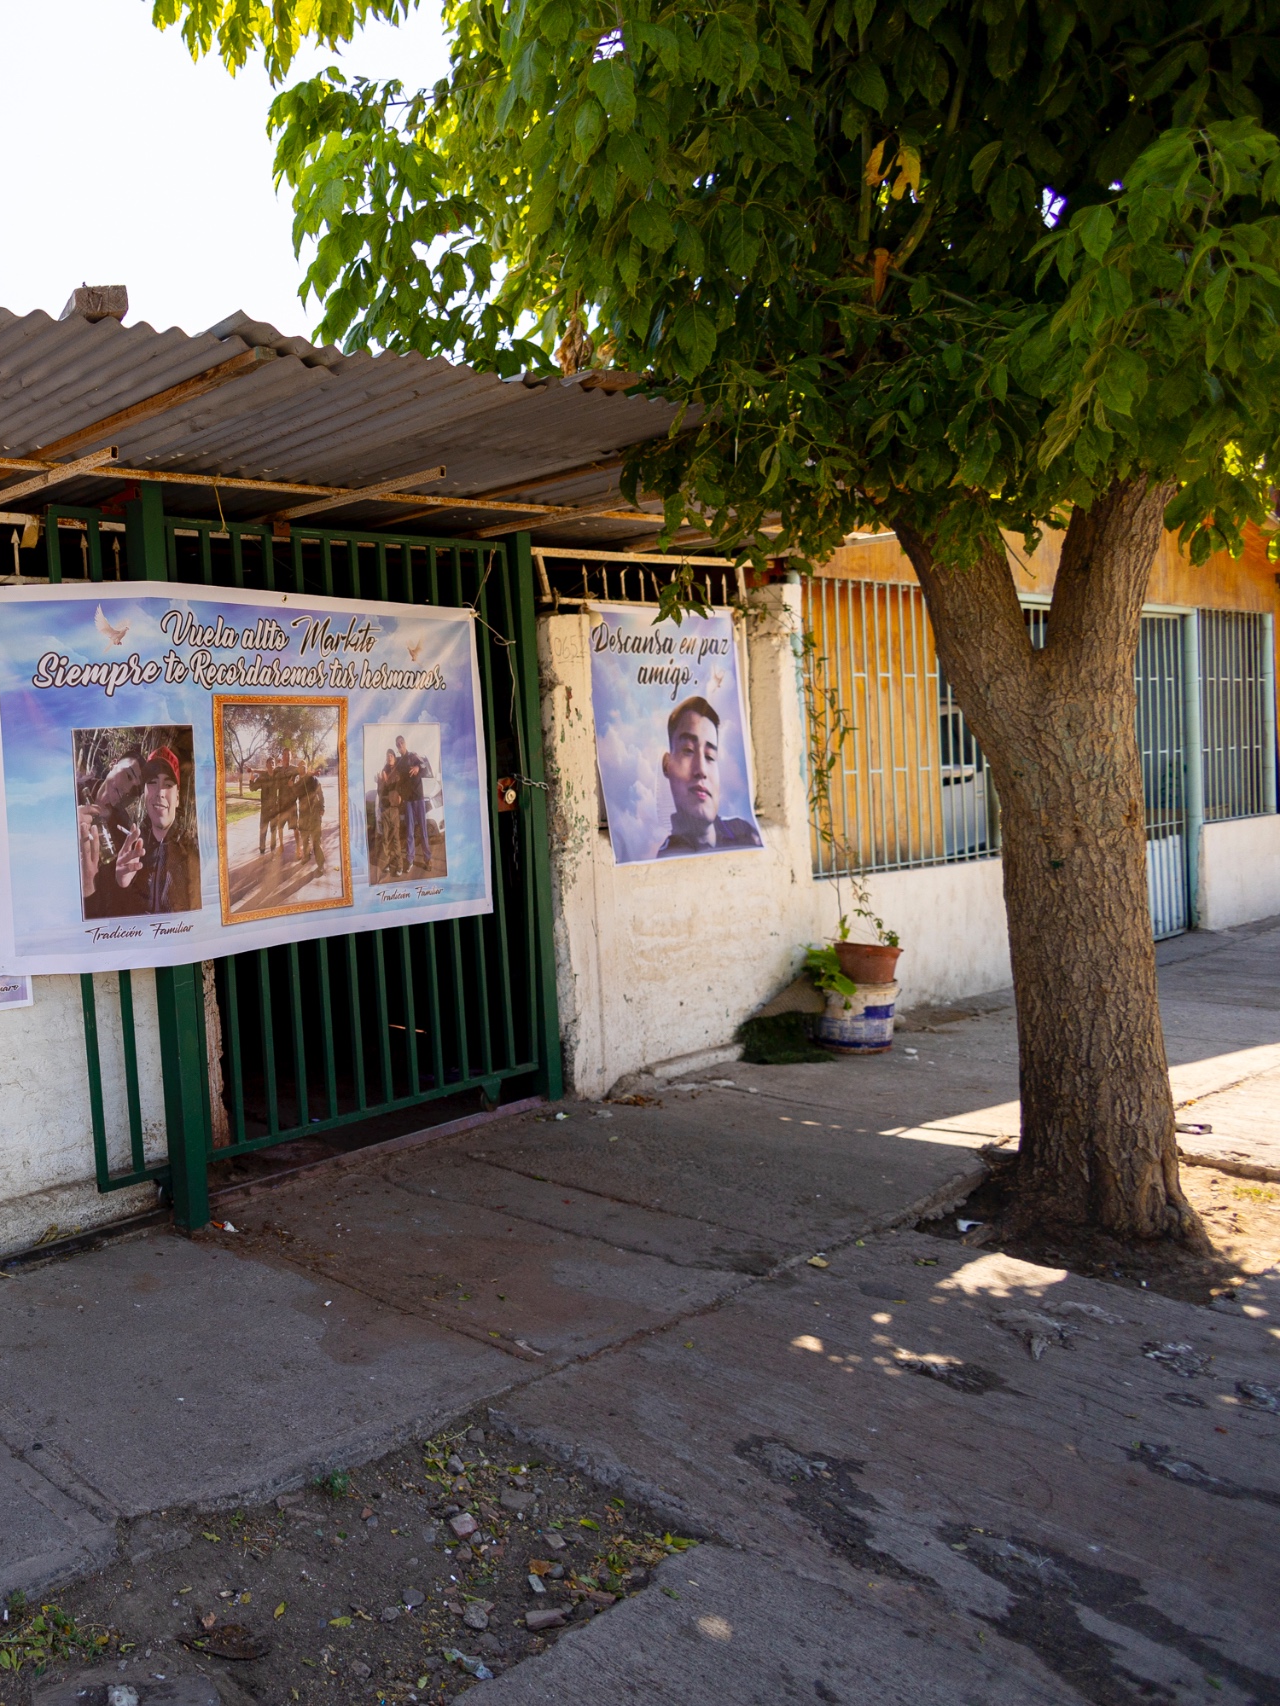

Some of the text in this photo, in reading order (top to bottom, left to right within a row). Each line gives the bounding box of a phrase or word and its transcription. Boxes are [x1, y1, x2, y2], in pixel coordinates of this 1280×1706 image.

[160, 610, 239, 648] Vuela
[291, 615, 381, 658] Markito
[592, 622, 729, 665] Descansa en paz
[32, 649, 446, 697] Siempre te Recordaremos tus hermanos.
[637, 658, 698, 700] amigo.
[85, 921, 194, 943] Tradición Familiar
